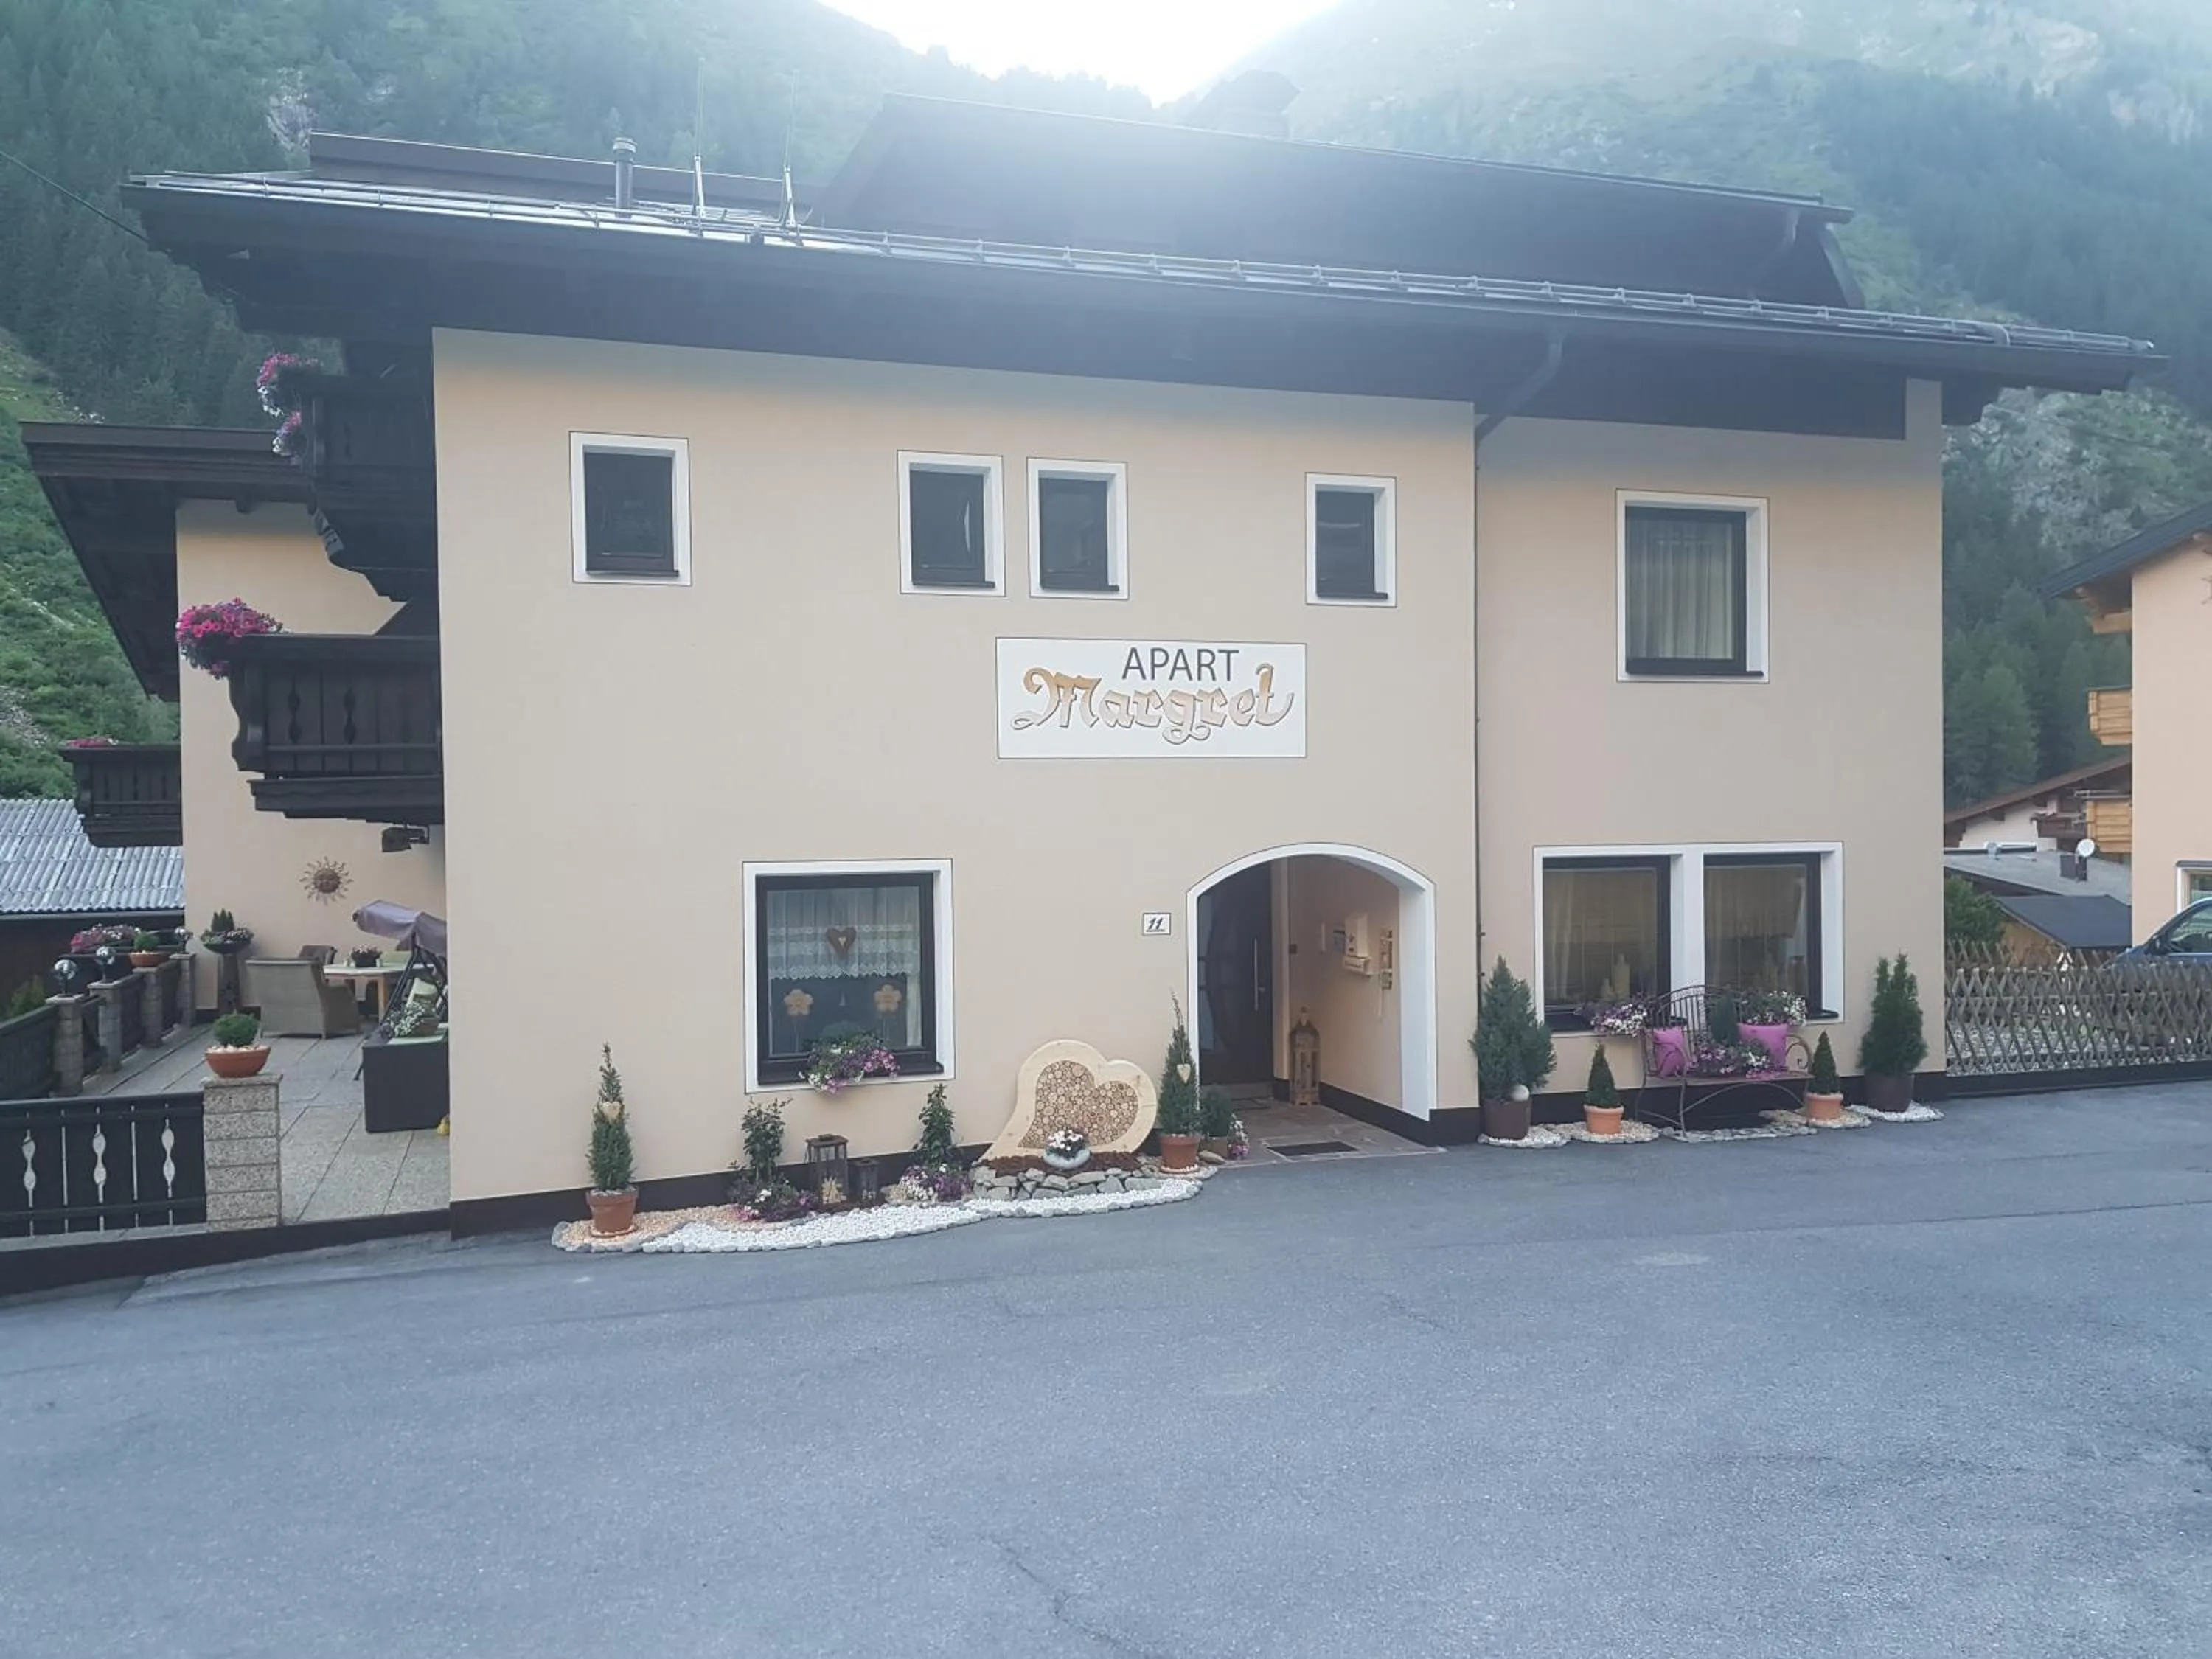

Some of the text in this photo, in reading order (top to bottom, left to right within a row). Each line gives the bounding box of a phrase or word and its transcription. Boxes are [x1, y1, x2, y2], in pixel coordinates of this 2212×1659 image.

[1121, 647, 1239, 681] APART
[1010, 662, 1295, 745] Margret
[1147, 917, 1164, 930] 11
